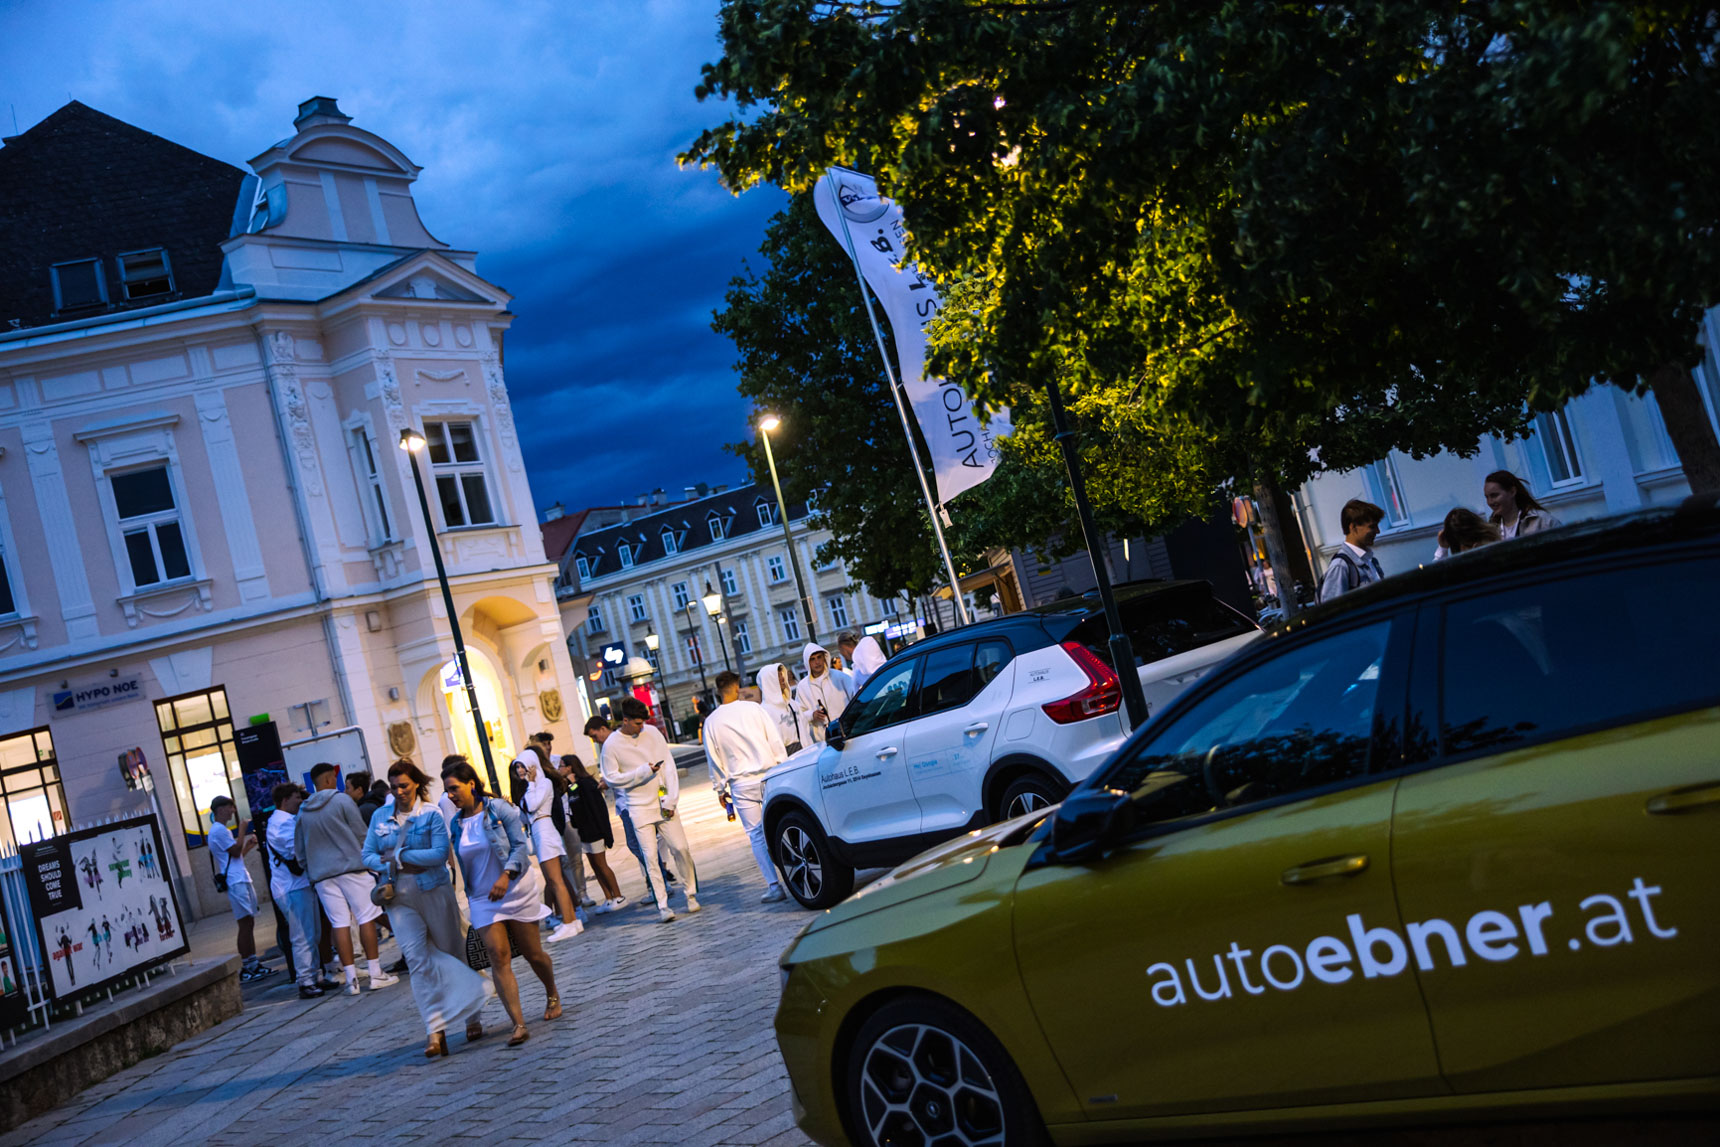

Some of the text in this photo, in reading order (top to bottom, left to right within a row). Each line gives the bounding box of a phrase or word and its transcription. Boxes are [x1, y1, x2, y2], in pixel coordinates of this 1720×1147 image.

[75, 686, 111, 702] HYPO
[112, 680, 139, 694] NOE
[821, 771, 845, 783] Autohaus
[38, 860, 60, 873] DREAMS
[40, 870, 62, 883] SHOULD
[45, 880, 61, 891] COME
[48, 889, 63, 901] TRUE
[1146, 877, 1678, 1008] autoebner.at
